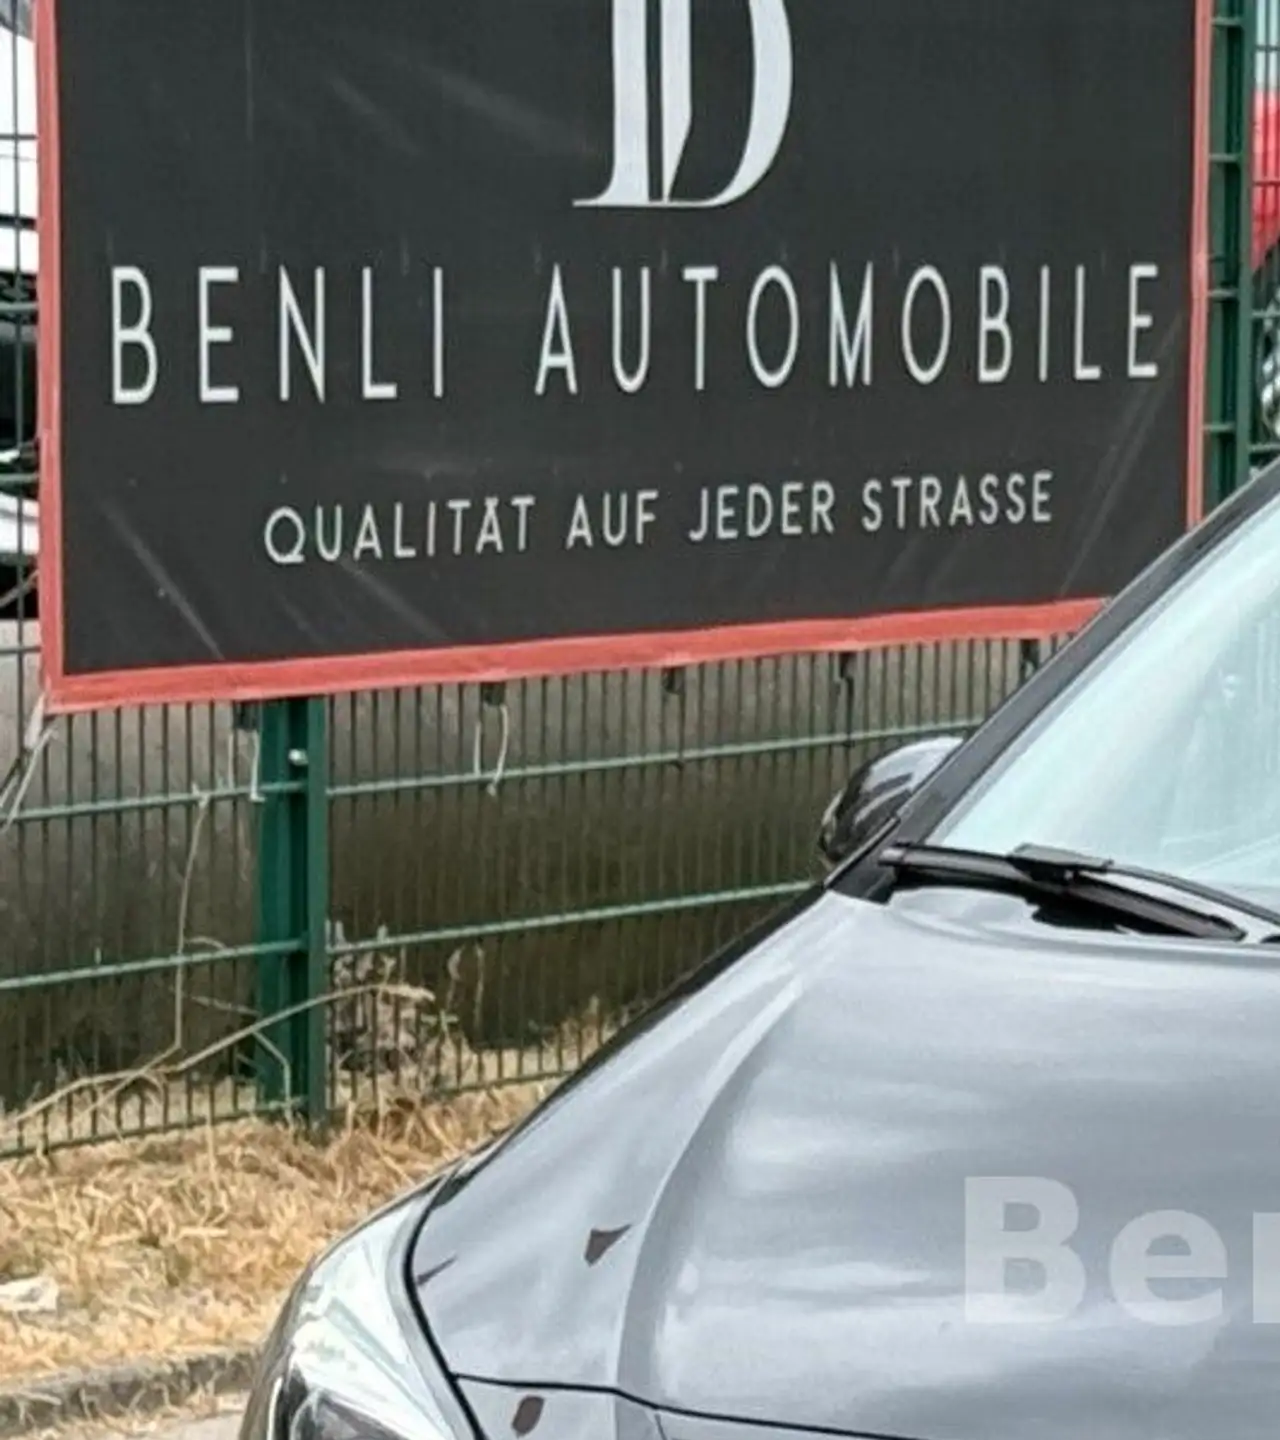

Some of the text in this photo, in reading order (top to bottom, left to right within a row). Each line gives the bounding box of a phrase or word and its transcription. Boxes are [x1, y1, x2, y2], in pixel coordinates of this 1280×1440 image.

[111, 260, 1158, 404] BENLI AUTOMOBILE
[264, 469, 1053, 564] QUALITÄT AUF JEDER STRASSE
